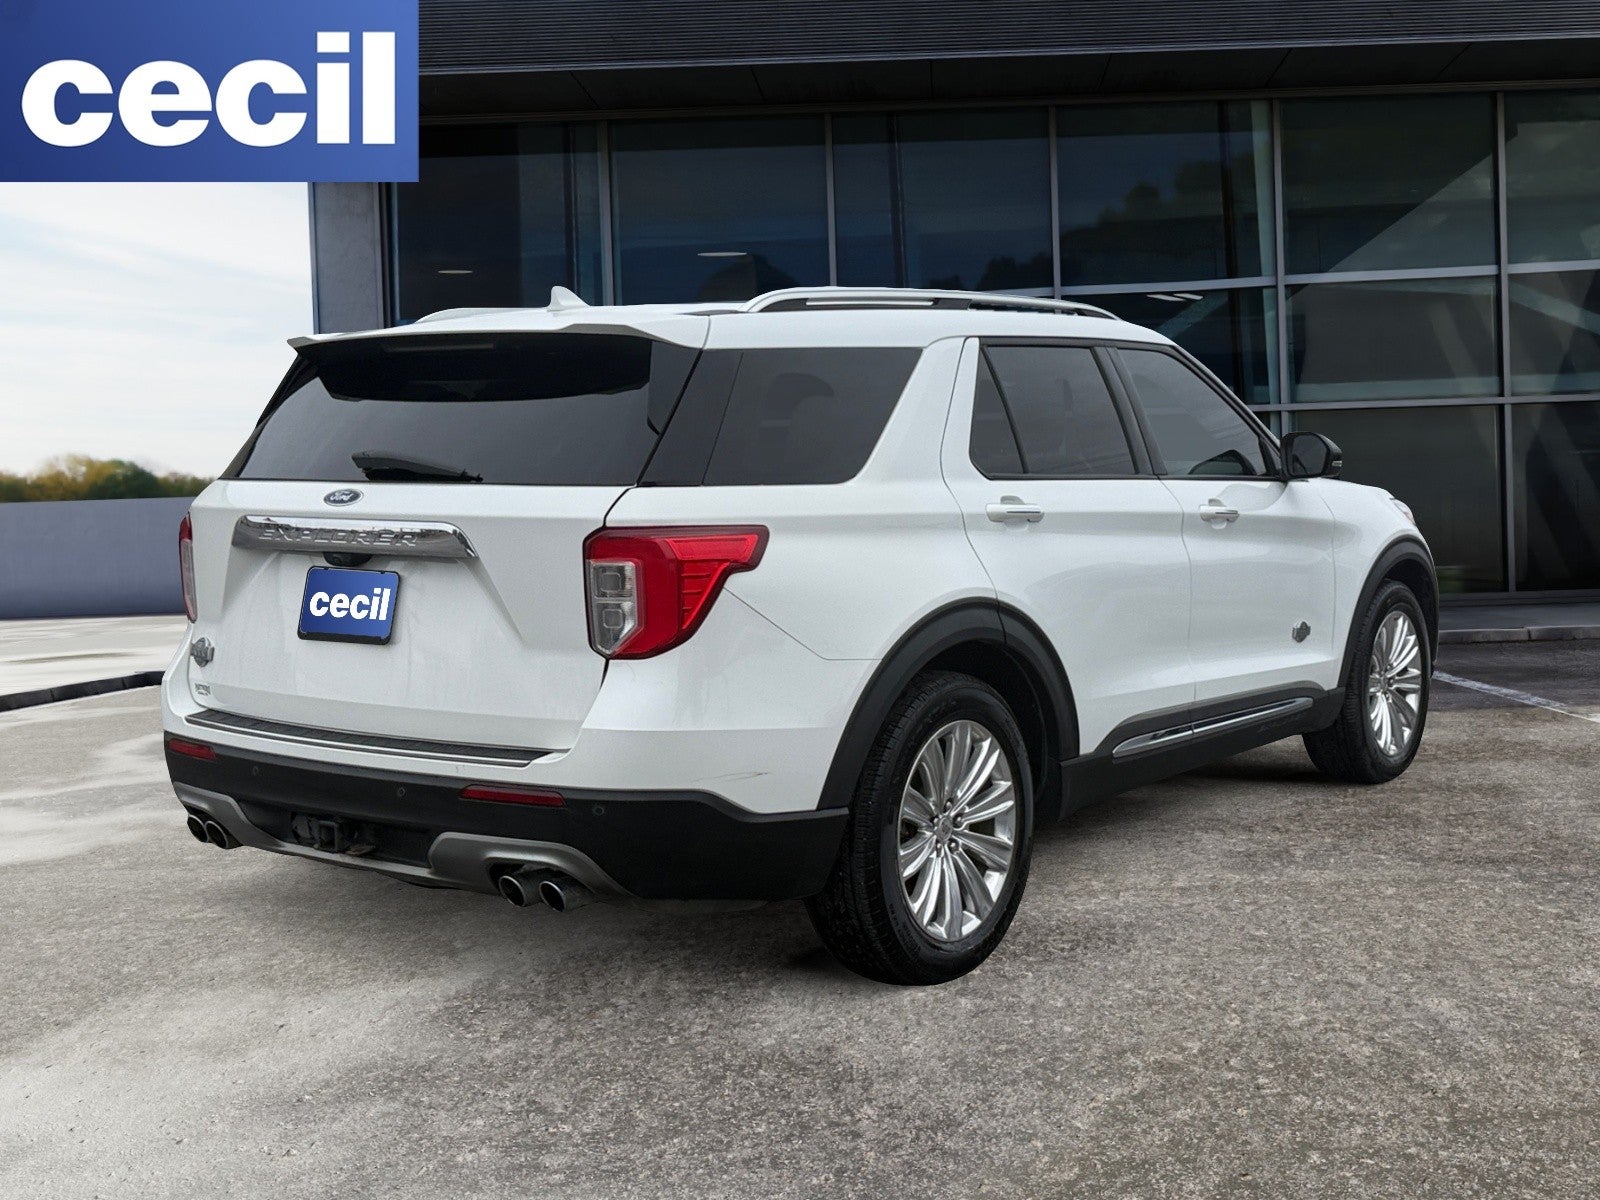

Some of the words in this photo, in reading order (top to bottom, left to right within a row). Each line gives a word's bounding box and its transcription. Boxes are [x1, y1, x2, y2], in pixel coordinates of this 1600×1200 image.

[329, 491, 355, 502] Ford
[258, 525, 421, 547] EXPLORER
[309, 587, 391, 621] cecil
